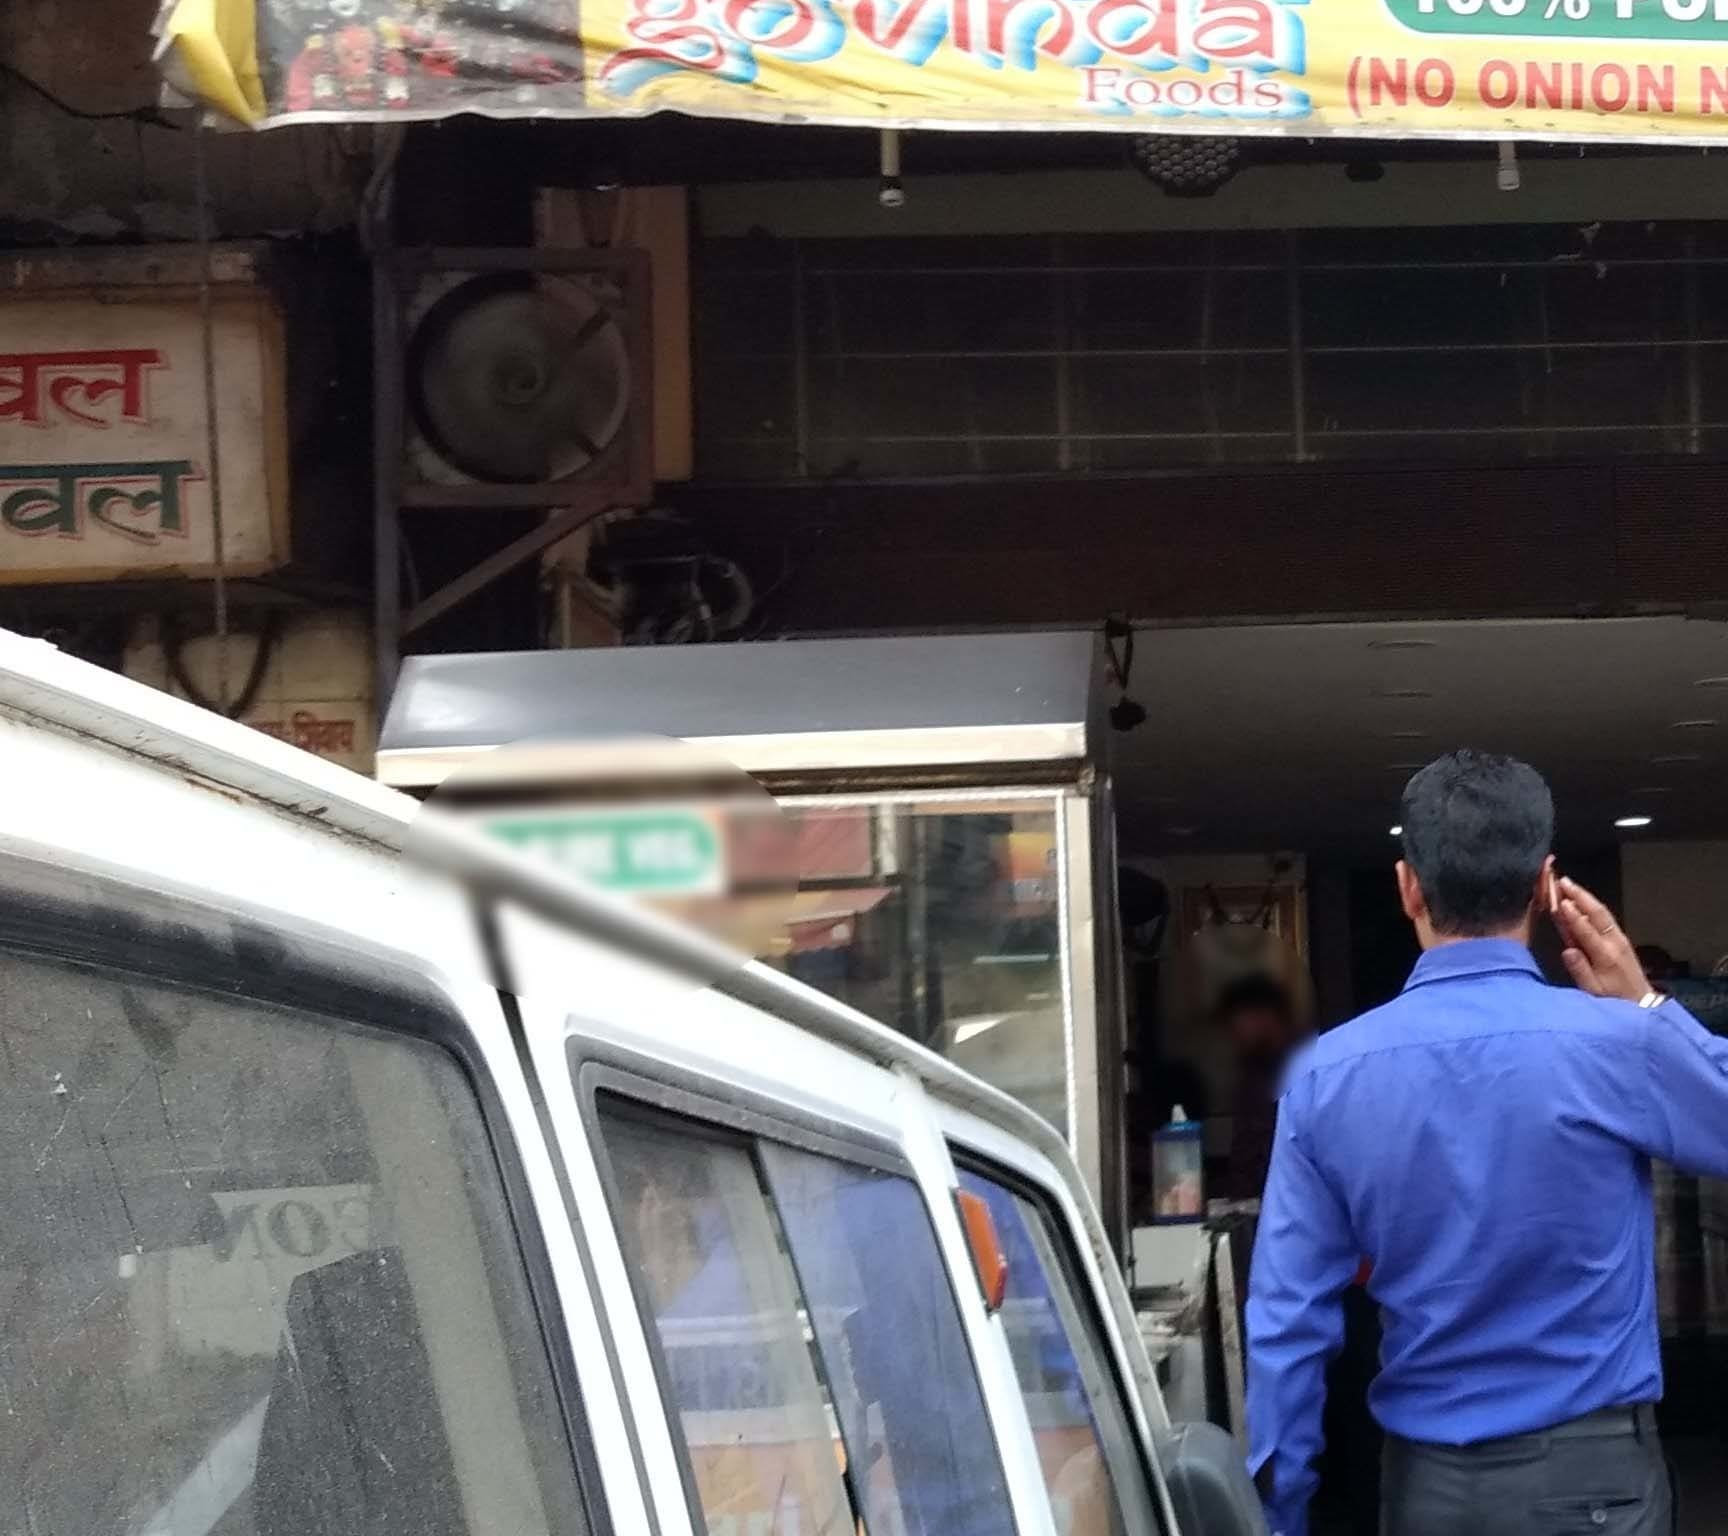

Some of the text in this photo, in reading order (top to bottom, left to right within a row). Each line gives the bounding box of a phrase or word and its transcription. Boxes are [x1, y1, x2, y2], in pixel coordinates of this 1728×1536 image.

[1082, 66, 1292, 114] Foods
[1346, 55, 1455, 118] (NO
[1478, 60, 1676, 115] ONION
[0, 349, 169, 430] वल
[0, 460, 205, 546] वल
